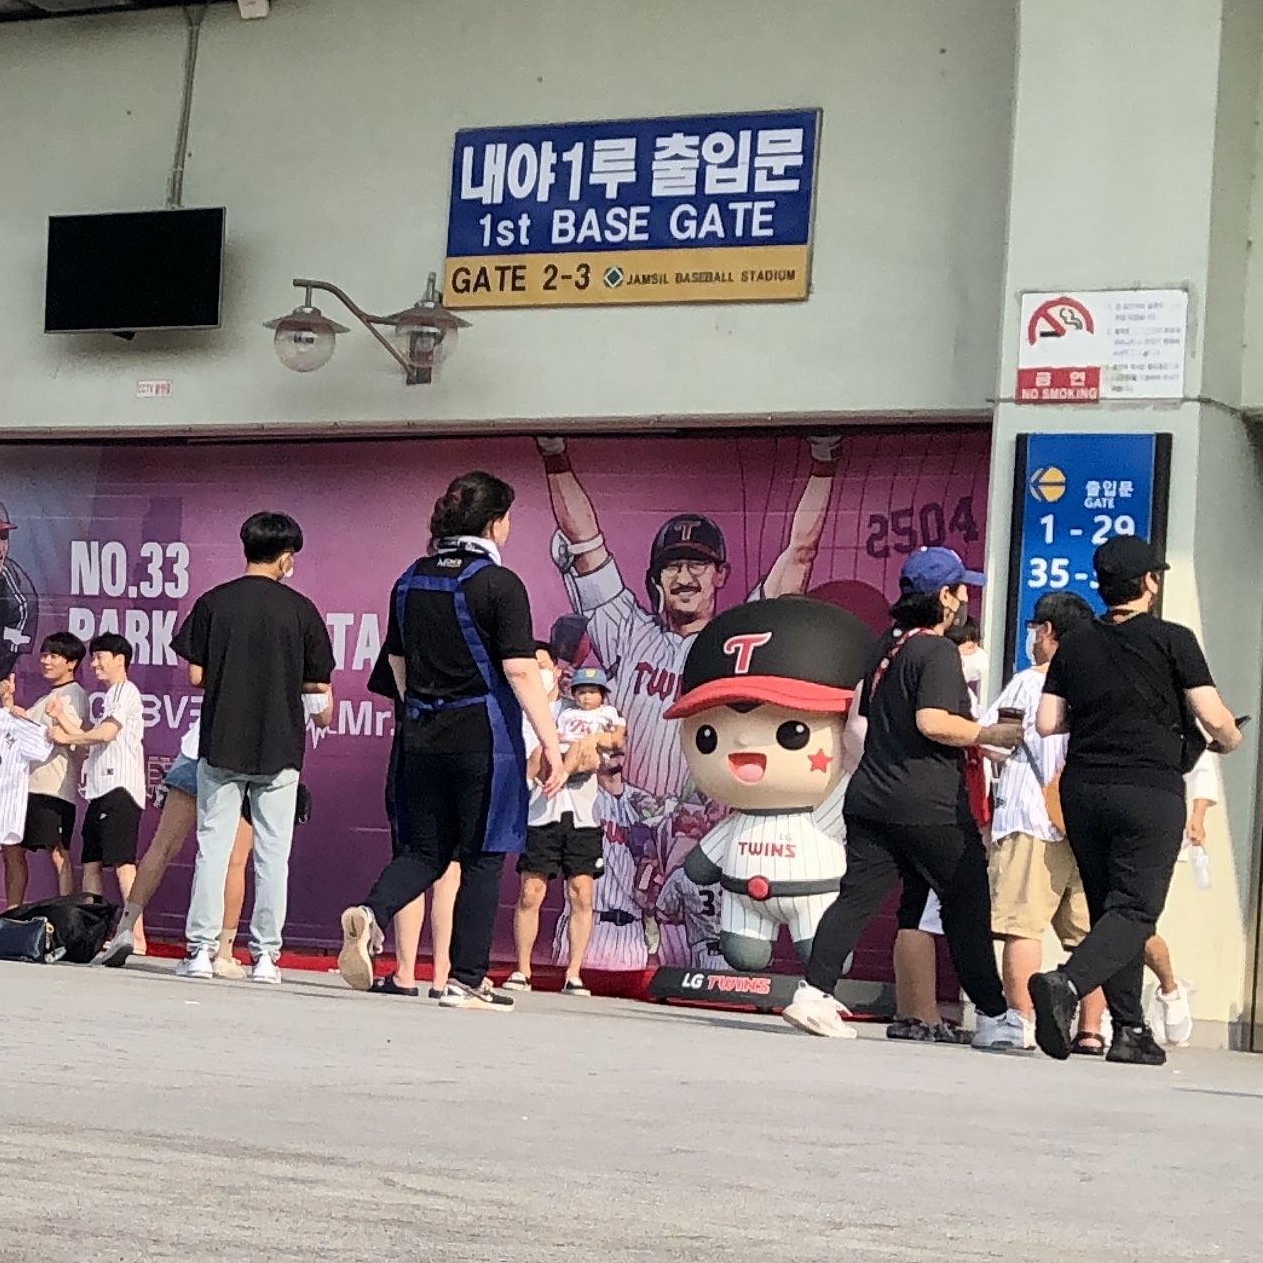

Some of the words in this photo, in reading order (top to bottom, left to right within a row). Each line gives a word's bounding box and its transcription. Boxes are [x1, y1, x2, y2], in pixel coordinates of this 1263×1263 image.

[460, 137, 637, 205] 내야1루
[651, 127, 804, 198] 출입문
[479, 213, 531, 247] 1st
[551, 205, 651, 245] BASE
[669, 200, 776, 240] GATE
[451, 264, 527, 294] GATE
[542, 262, 591, 290] 2-3
[626, 272, 669, 285] JAMSIL
[674, 271, 734, 284] BASEBALL
[741, 269, 796, 282] STADIUM
[1021, 387, 1039, 400] NO
[1042, 387, 1098, 400] SMOKING
[1083, 497, 1115, 509] GATE
[866, 496, 978, 558] 2504
[70, 540, 189, 598] NO.33
[738, 841, 797, 858] TWINS
[681, 972, 705, 989] LG
[706, 974, 772, 995] TWINS
